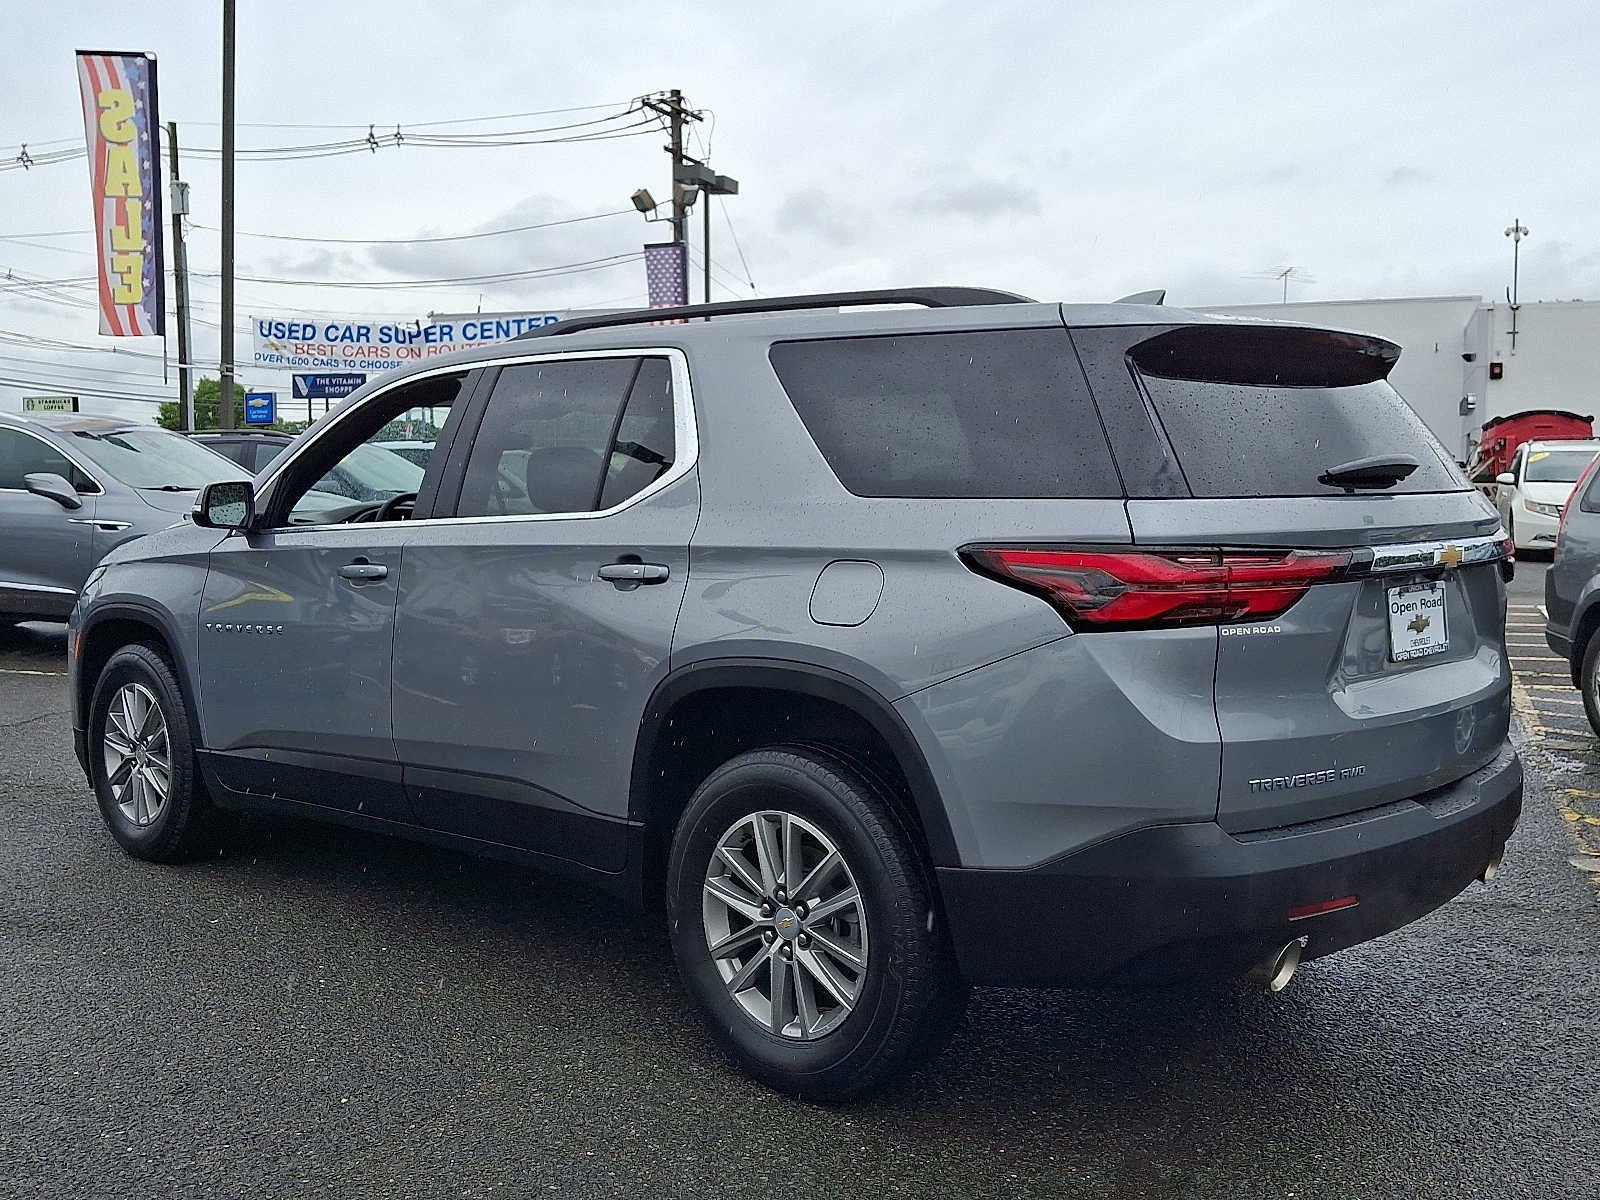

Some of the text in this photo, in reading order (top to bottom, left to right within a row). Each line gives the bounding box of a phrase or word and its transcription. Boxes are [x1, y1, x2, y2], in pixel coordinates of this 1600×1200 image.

[259, 320, 317, 341] USED
[324, 325, 371, 343] CAR
[379, 324, 453, 345] SUPER
[294, 343, 337, 357] BEST
[342, 345, 391, 359] CARS
[396, 346, 421, 359] ON
[254, 352, 283, 363] OVER
[312, 358, 339, 368] CARS
[344, 359, 356, 369] TO
[332, 377, 362, 385] VITAMIN
[1391, 595, 1442, 616] Open Road
[1221, 626, 1281, 636] OPEN ROAD
[1248, 765, 1367, 793] TRAVERSE AWD
